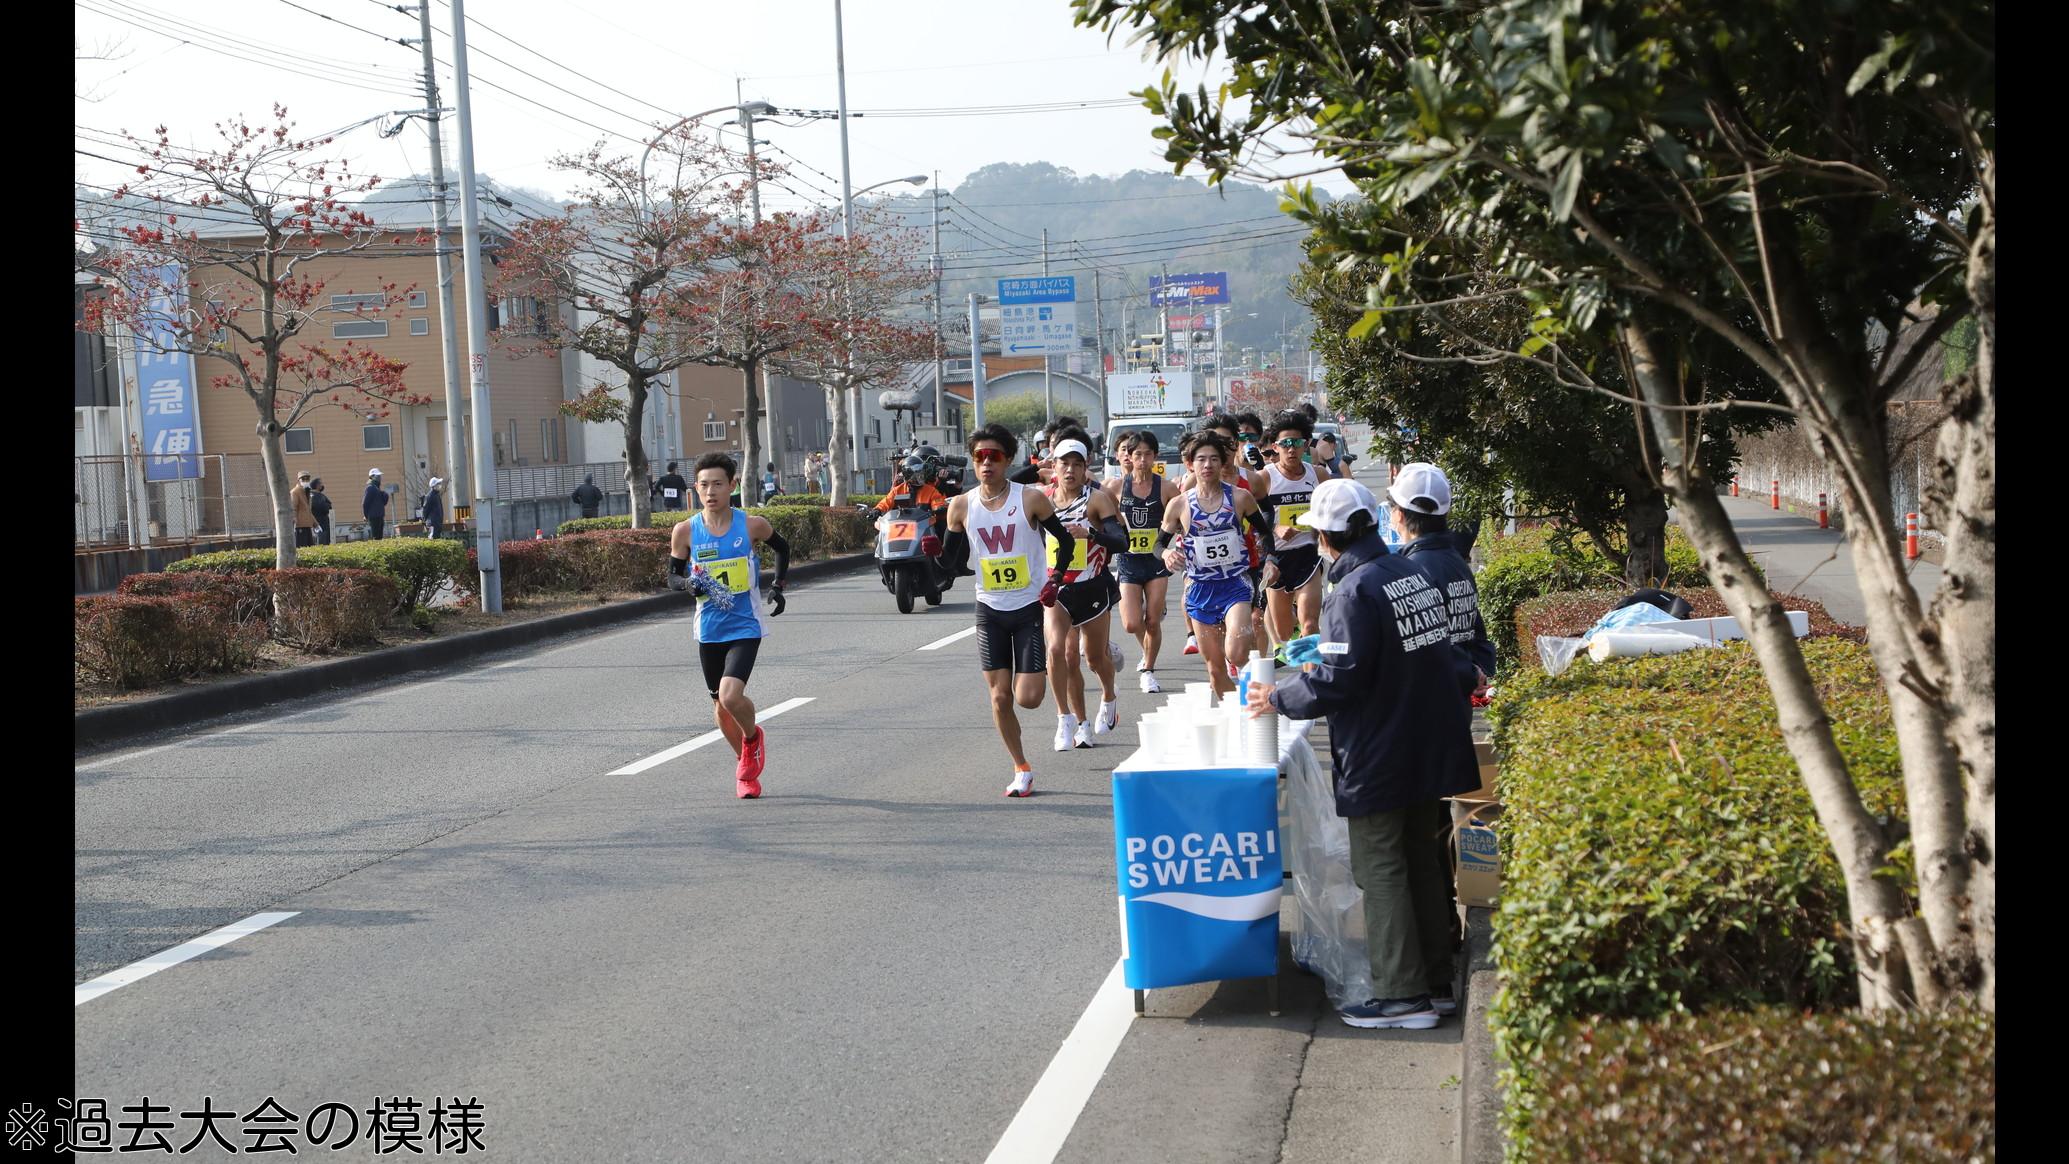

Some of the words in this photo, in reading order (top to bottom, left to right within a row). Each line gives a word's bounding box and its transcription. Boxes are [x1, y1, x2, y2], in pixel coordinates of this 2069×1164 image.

[895, 523, 908, 537] 7
[976, 523, 1017, 555] W
[1129, 536, 1149, 548] 18
[1206, 543, 1229, 560] 53
[715, 571, 730, 586] 1
[991, 567, 1017, 584] 19
[1126, 830, 1275, 862] POCARI
[1461, 841, 1494, 851] SWEAT
[1128, 856, 1264, 888] SWEAT
